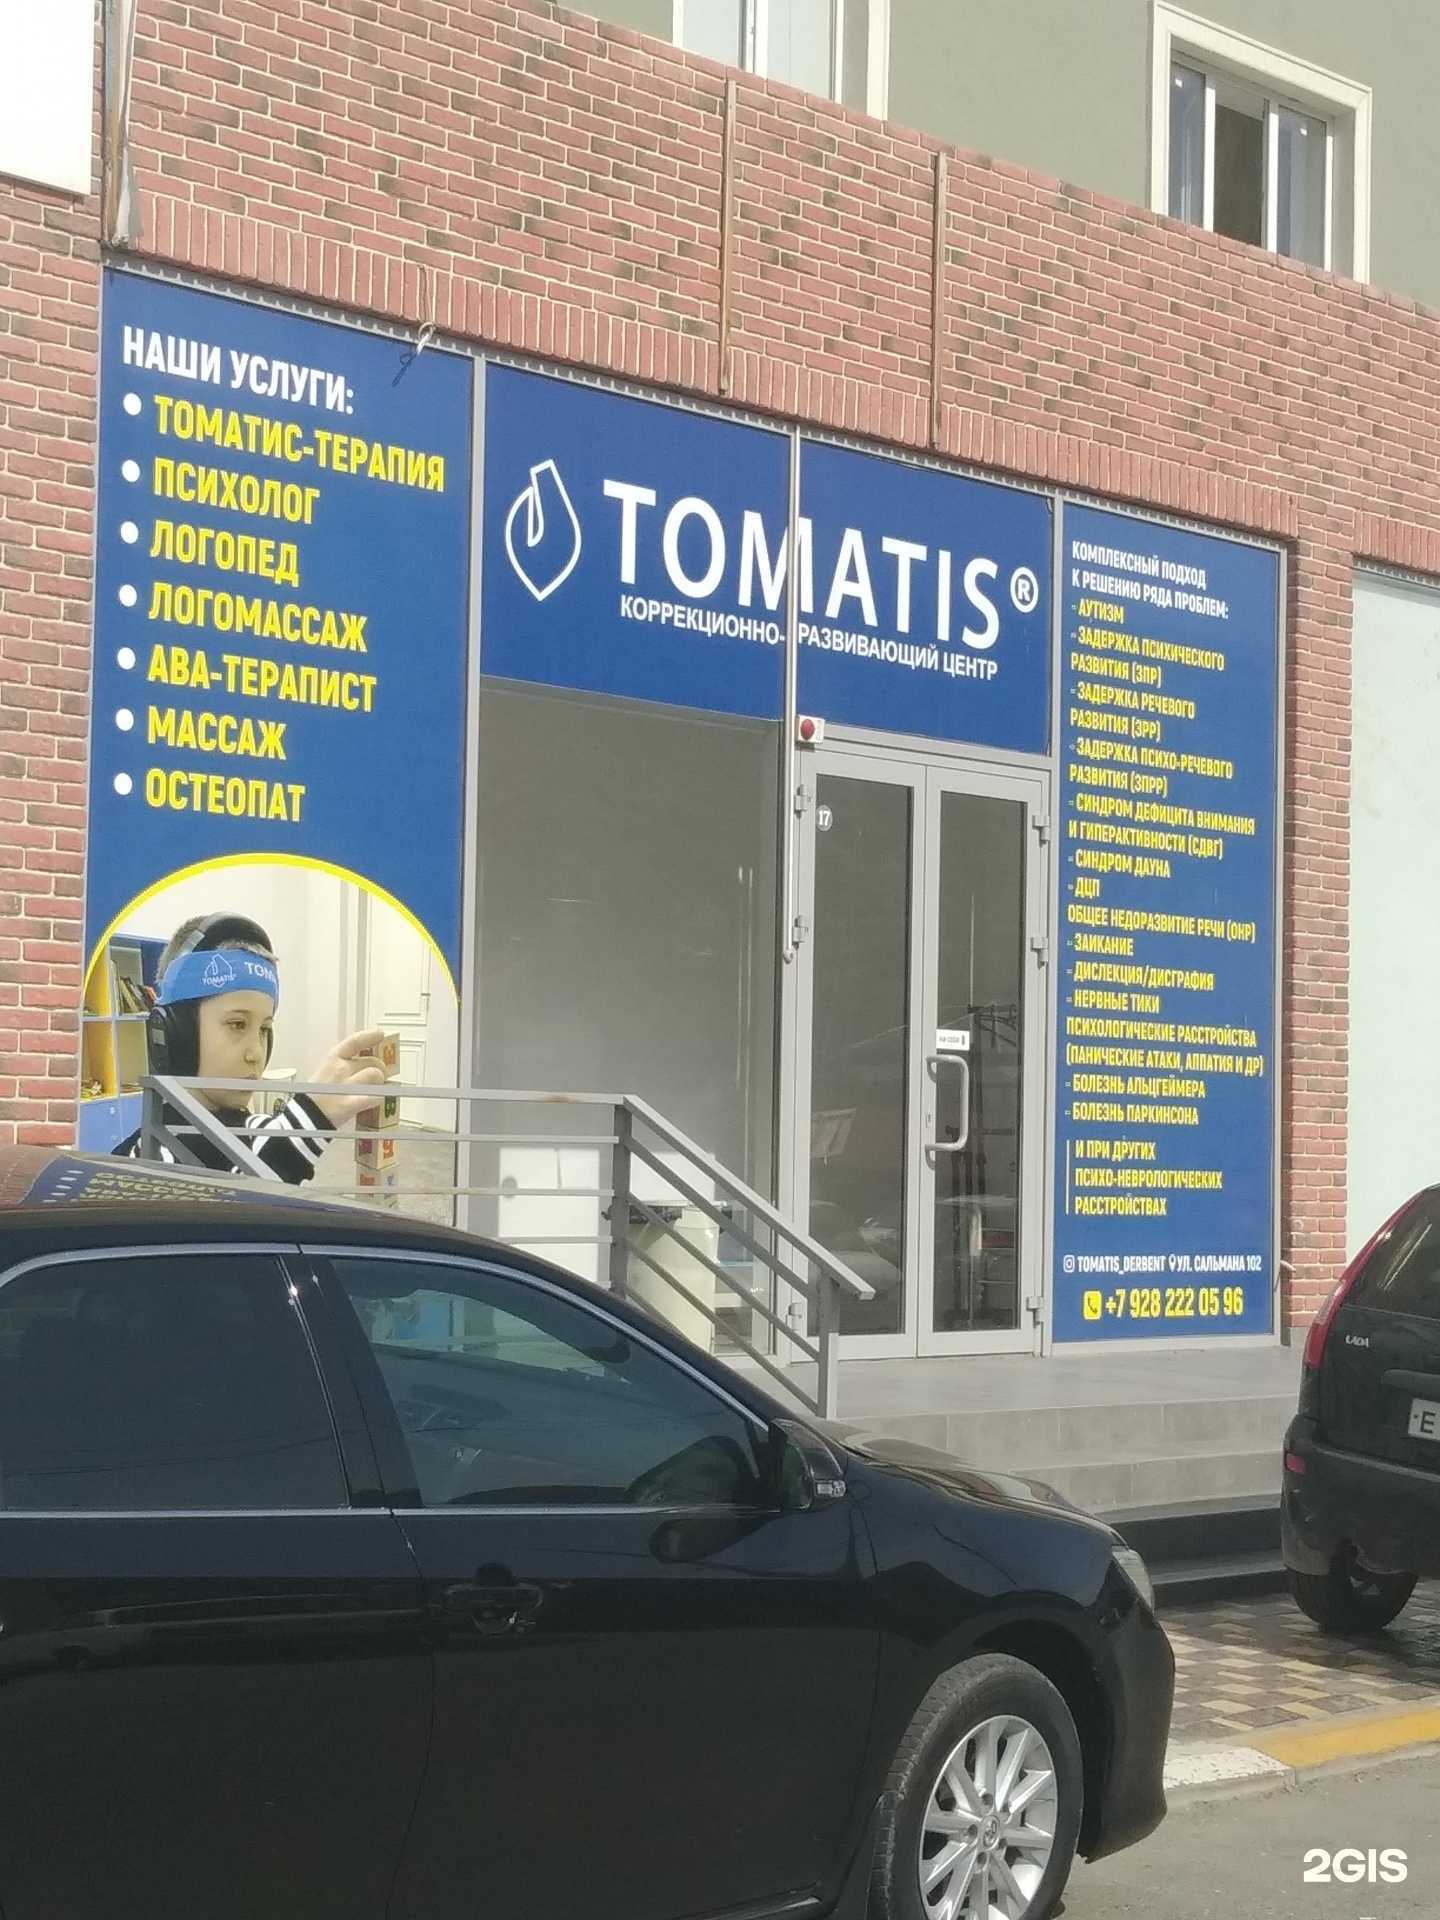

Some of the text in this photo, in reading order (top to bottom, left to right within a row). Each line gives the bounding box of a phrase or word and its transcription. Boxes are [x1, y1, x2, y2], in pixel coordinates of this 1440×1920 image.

[123, 325, 354, 414] НАШИ УСЛУГИ:
[154, 394, 445, 492] ТОМАТИС-ТЕРАПИЯ
[153, 457, 320, 524] ПСИХОЛОГ
[150, 520, 299, 587] ЛОГОПЕД
[1072, 541, 1207, 591] КОМПЛЕКСНЫЙ ПОДХОД
[1072, 569, 1229, 619] К РЕШЕНИЮ РЯДА ПРОБЛЕМ:
[149, 582, 368, 652] ЛОГОМАССАЖ
[1078, 599, 1124, 624] АУТИЗМ
[1078, 626, 1139, 655] ЗАДЕРЖКА
[1142, 639, 1224, 671] ПСИХИЧЕСКОГО
[147, 644, 377, 712] АВА-ТЕРАПИСТ
[942, 655, 997, 681] ЦЕНТР
[1071, 653, 1162, 688] РАЗВИТИЯ (ЗПР)
[1078, 682, 1139, 709] ЗАДЕРЖКА
[1141, 694, 1195, 719] РЕЧЕВОГО
[147, 705, 287, 760] МАССАЖ
[1070, 708, 1161, 742] РАЗВИТИЯ (ЗРР)
[1077, 737, 1138, 764] ЗАДЕРЖКА
[1141, 748, 1233, 779] ПСИХО-РЕЧЕВОГО
[145, 768, 306, 822] ОСТЕОПАТ
[1070, 764, 1168, 798] РАЗВИТИЯ (ЗПРР)
[1076, 793, 1133, 818] СИНДРОМ
[1135, 804, 1194, 828] ДЕФИЦИТА
[1197, 812, 1255, 835] ВНИМАНИЯ
[1069, 821, 1223, 859] И ГИПЕРАКТИВНОСТИ (СДВГ)
[1076, 849, 1132, 873] СИНДРОМ
[1134, 857, 1171, 878] ДАУНА
[1075, 878, 1100, 899] ДЦП
[1068, 905, 1255, 943] ОБЩЕЕ НЕДОРАЗВИТИЕ РЕЧИ (ОНР)
[1075, 933, 1134, 956] ЗАИКАНИЕ
[1074, 990, 1129, 1010] НЕРВНЫЕ
[1131, 994, 1159, 1013] ТИКИ
[1067, 1017, 1256, 1047] ПСИХОЛОГИЧЕСКИЕ РАССТРОЙСТВА
[1066, 1043, 1144, 1068] (ПАНИЧЕСКИЕ
[1146, 1051, 1184, 1073] АТАКИ,
[1235, 1057, 1243, 1073] И
[1245, 1055, 1264, 1077] ДР)
[1073, 1074, 1125, 1095] БОЛЕЗНЬ
[1127, 1075, 1205, 1098] АЛЬЦГЕЙМЕРА
[1073, 1103, 1124, 1121] БОЛЕЗНЬ
[1126, 1104, 1199, 1125] ПАРКИНСОНА
[1075, 1140, 1156, 1162] И ПРИ ДРУГИХ
[1075, 1168, 1222, 1189] ПСИХО-НЕВРОЛОГИЧЕСКИХ
[1075, 1193, 1167, 1216] РАССТРОЙСТВАХ
[1078, 1255, 1261, 1274] TOMATIS_DERBENT УЛ. САЛЬМАНА 102
[1105, 1287, 1244, 1318] +7 928 222 05 96
